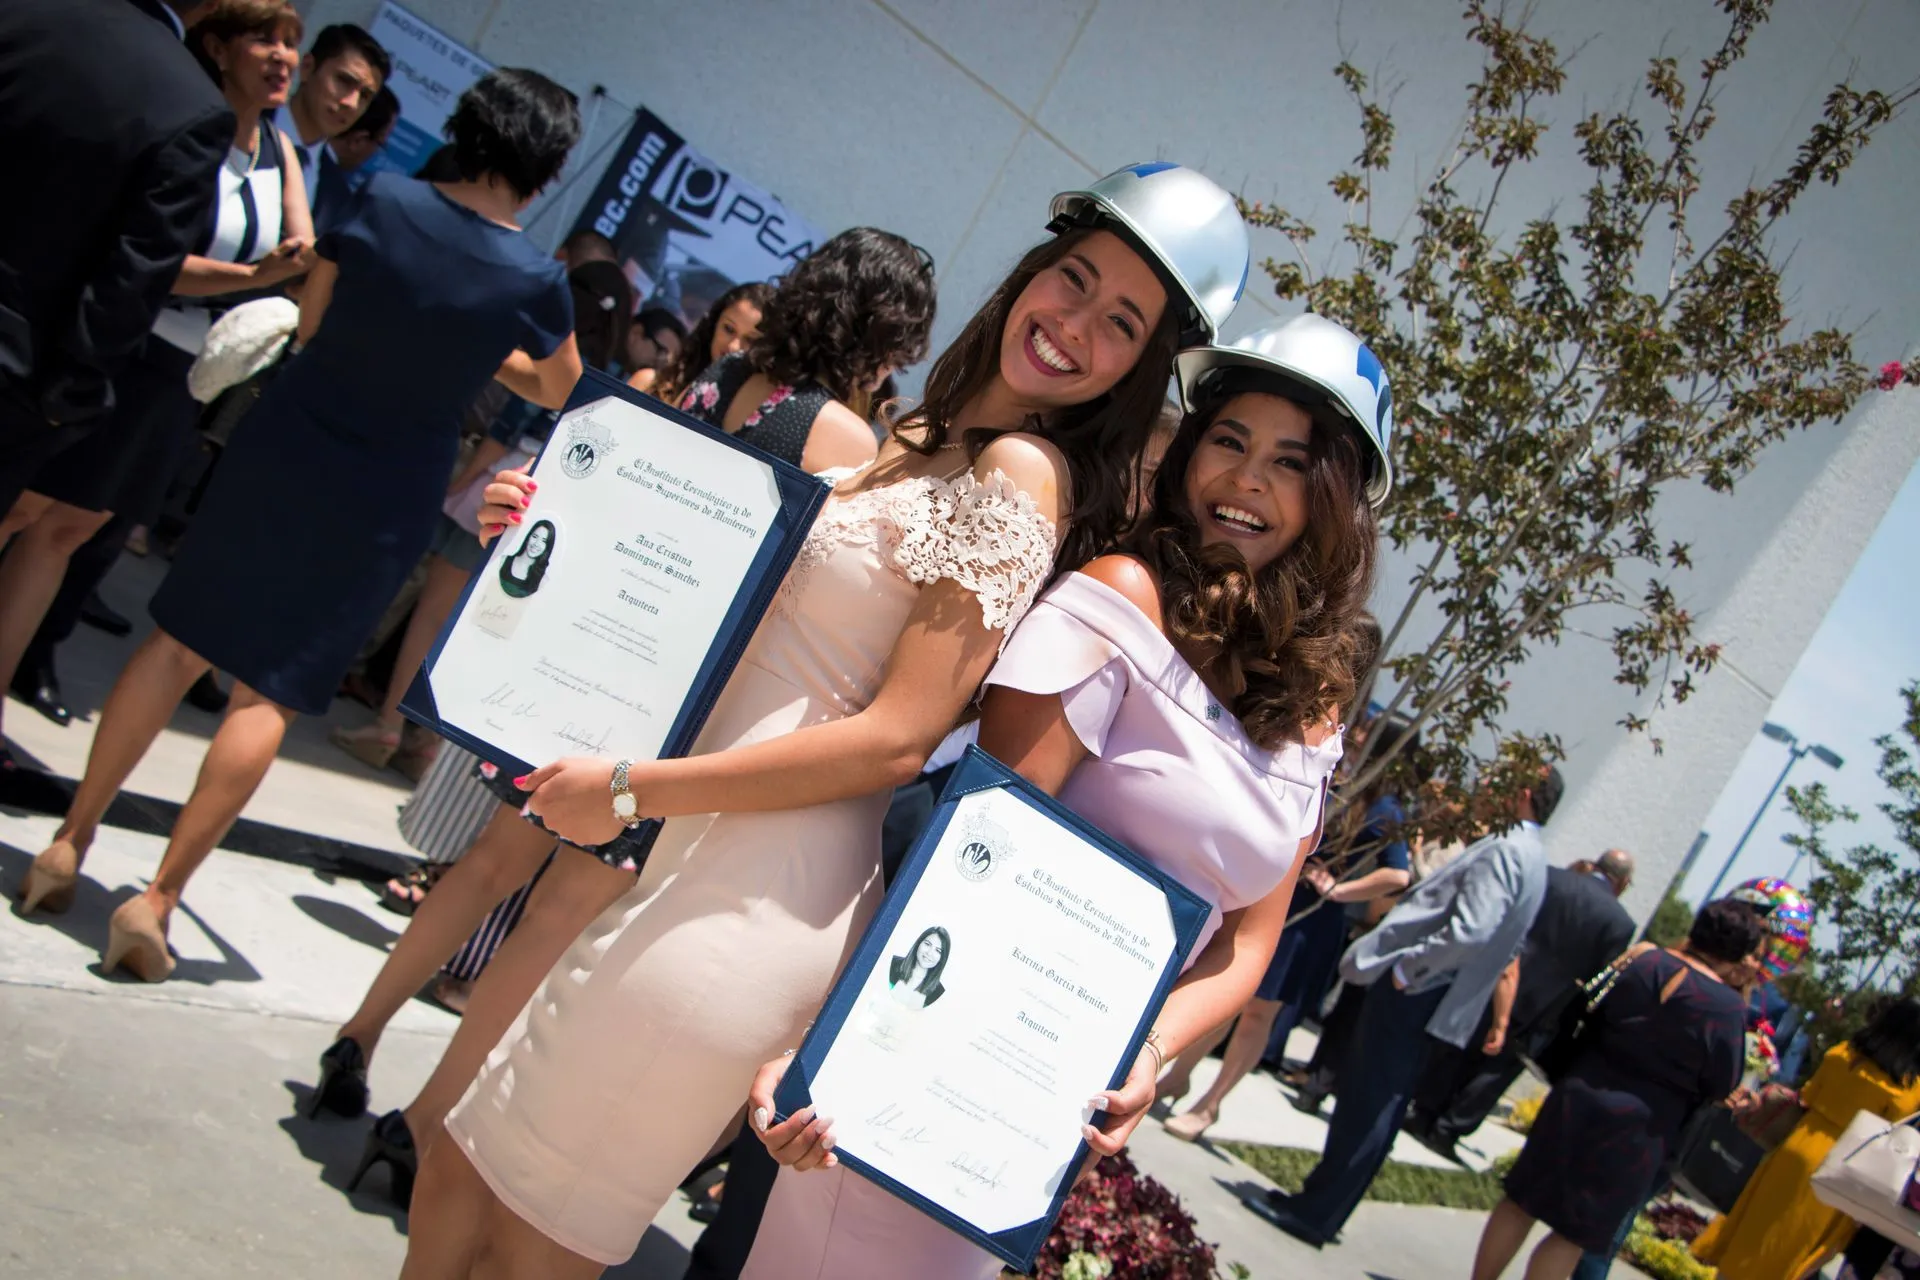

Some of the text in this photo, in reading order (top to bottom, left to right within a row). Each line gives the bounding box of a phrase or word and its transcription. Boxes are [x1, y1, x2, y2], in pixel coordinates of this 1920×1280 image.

[616, 464, 655, 489] Estudios
[654, 482, 701, 511] Superiores
[701, 505, 713, 516] de
[711, 508, 756, 539] Monterrey
[642, 462, 682, 488] Instituto
[732, 506, 740, 517] y
[741, 507, 751, 519] de
[635, 534, 654, 550] Ana
[656, 544, 692, 567] Cristina
[617, 589, 659, 615] Arquitecta
[1015, 874, 1053, 904] Estudios
[1056, 898, 1100, 933] Superiores
[1102, 929, 1112, 940] de
[1112, 935, 1155, 971] Monterrey
[1043, 874, 1082, 904] Instituto
[1140, 937, 1150, 950] de
[1010, 947, 1044, 973] Karina
[1016, 1011, 1058, 1042] Arquitecta
